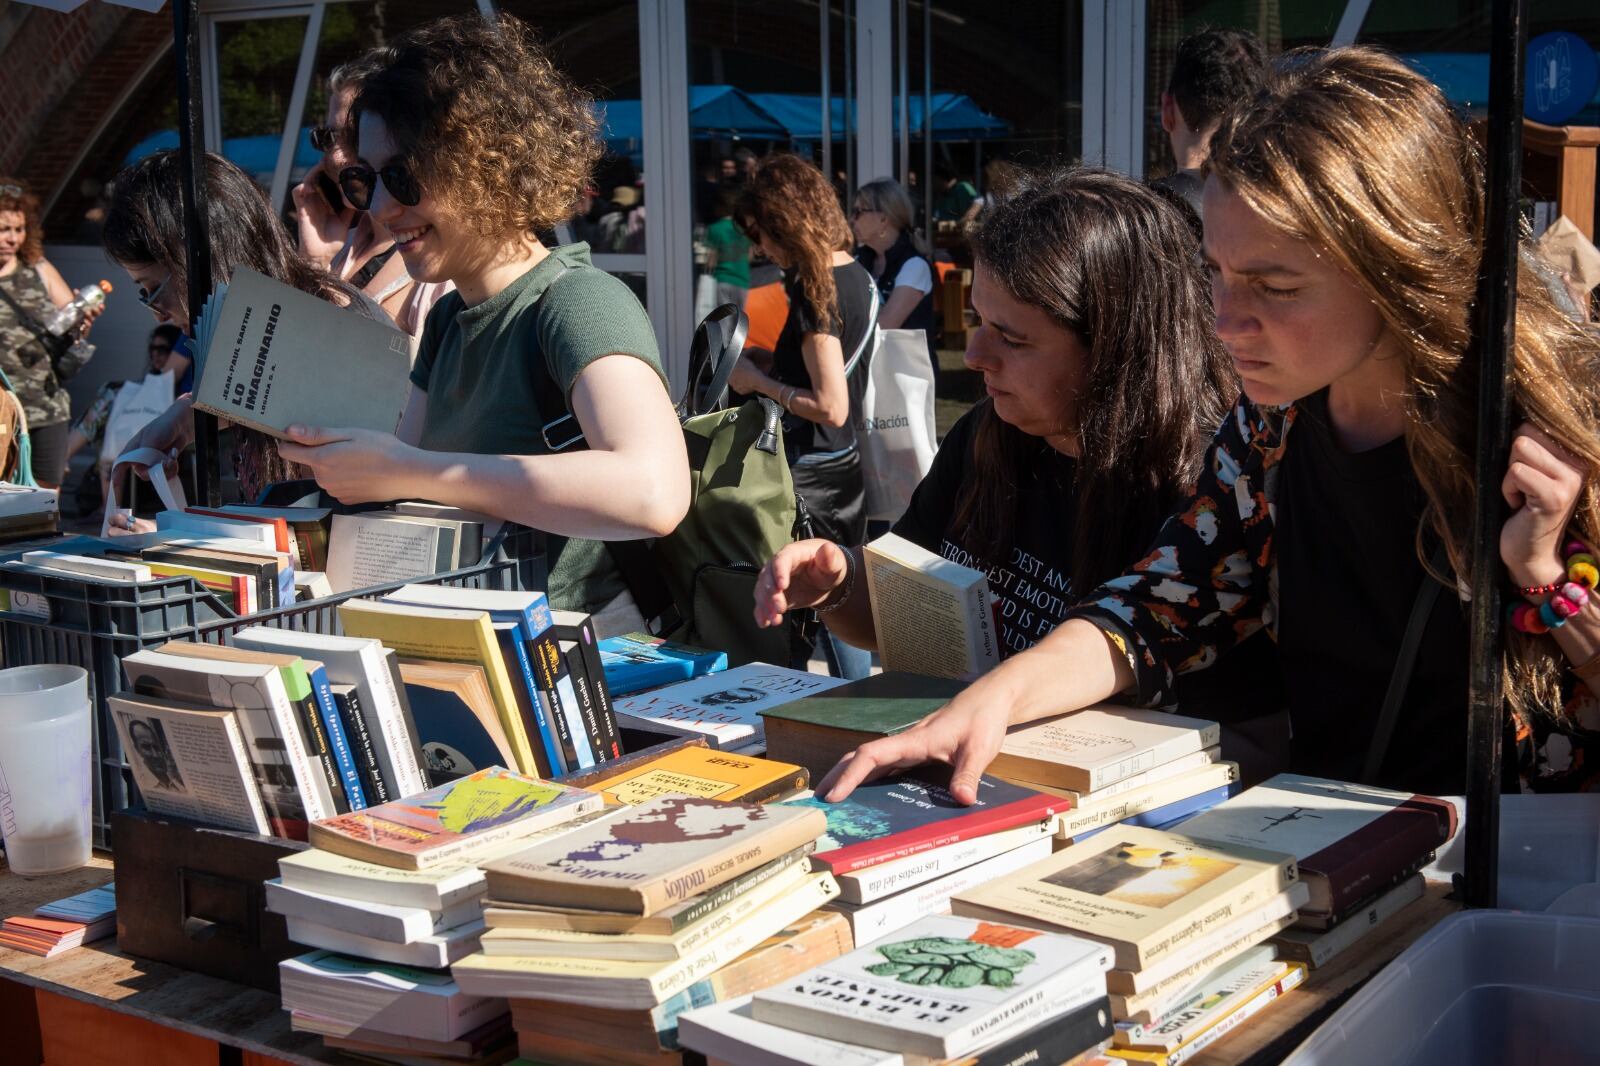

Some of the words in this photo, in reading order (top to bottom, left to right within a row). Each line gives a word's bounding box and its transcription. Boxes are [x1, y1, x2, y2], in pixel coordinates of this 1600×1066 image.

[223, 346, 240, 401] JEAN-PAUL
[237, 306, 253, 344] SARTRE
[245, 303, 282, 411] IMAGINARIO
[232, 383, 246, 406] LO
[866, 414, 909, 431] Nación
[1043, 568, 1072, 593] AN
[976, 588, 985, 620] George
[1014, 581, 1067, 618] EMOTI
[1018, 609, 1035, 629] IS
[984, 631, 992, 657] Arthur
[577, 677, 591, 708] Guebel
[351, 698, 358, 709] La
[587, 708, 599, 736] Daniel
[320, 684, 333, 711] Sylvia
[329, 714, 350, 767] Iparraguirre
[346, 770, 356, 782] El
[361, 732, 368, 741] de
[364, 739, 371, 749] la
[325, 755, 337, 788] Auschwitz
[376, 781, 387, 799] Pablo
[1100, 806, 1109, 819] al
[1109, 801, 1129, 818] Junto
[1070, 810, 1099, 830] pianista
[735, 846, 762, 864] SAMUEL
[923, 858, 940, 872] Los
[707, 858, 735, 878] BECKETT
[883, 871, 897, 885] del
[898, 863, 923, 881] restos
[663, 869, 706, 900] molloy
[868, 876, 882, 891] día
[687, 902, 713, 921] Auster
